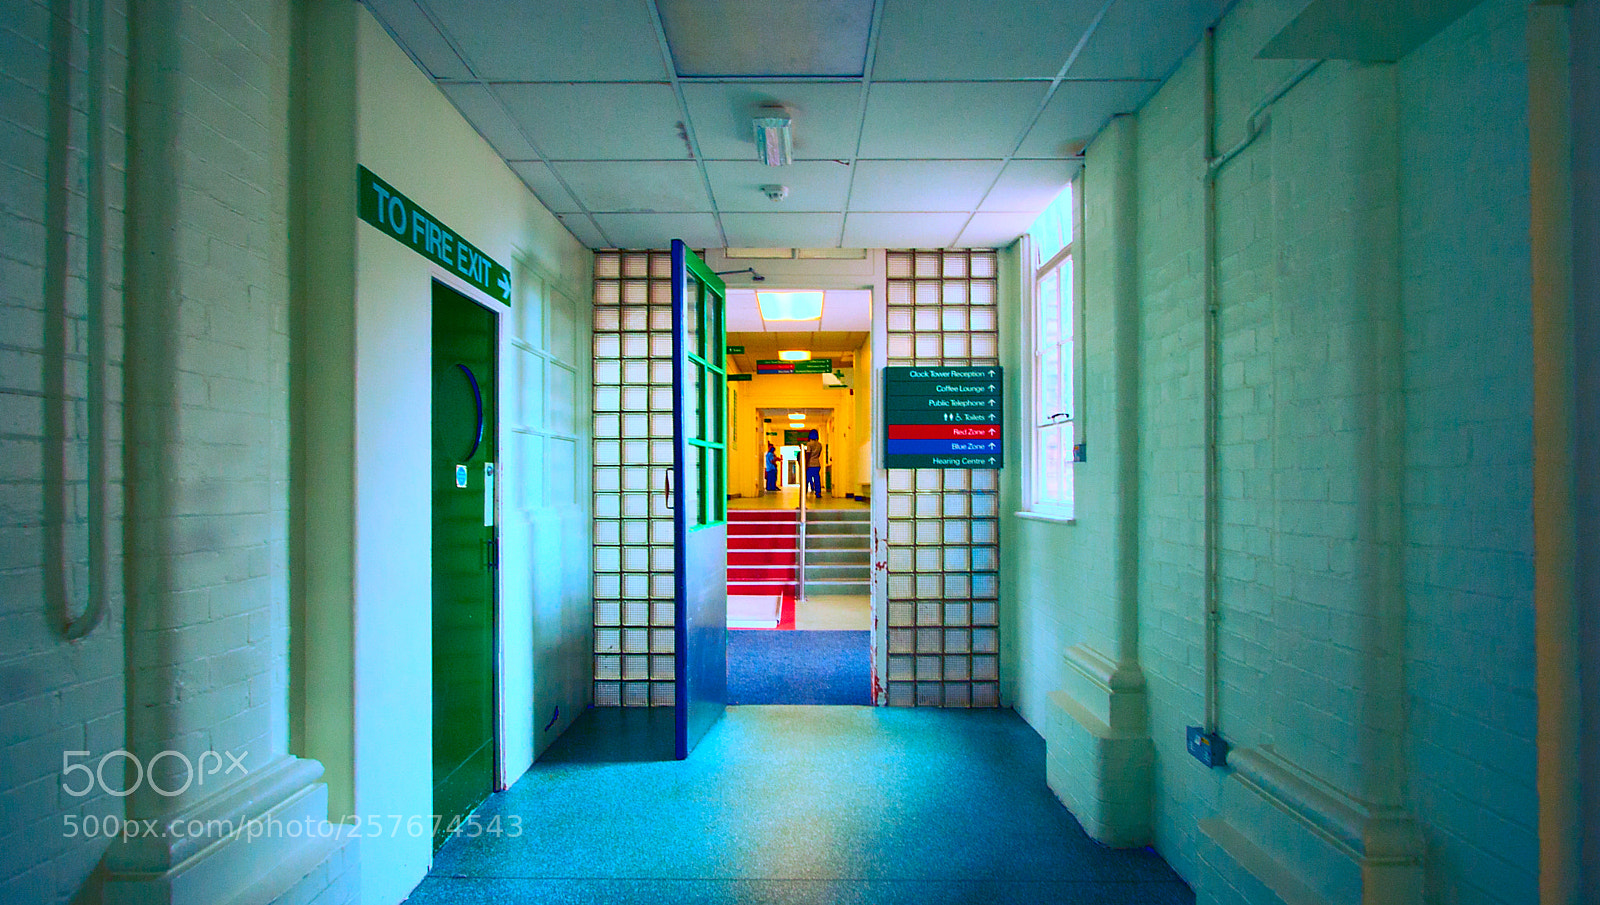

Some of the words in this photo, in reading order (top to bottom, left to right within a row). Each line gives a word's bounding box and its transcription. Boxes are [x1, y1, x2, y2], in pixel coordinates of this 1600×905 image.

[372, 182, 407, 235] TO
[412, 210, 453, 266] FIRE
[457, 241, 492, 287] EXIT
[951, 371, 985, 379] Reception
[959, 385, 985, 393] Lounge
[928, 399, 949, 407] Public
[951, 399, 985, 408] Telephone
[965, 413, 985, 421] Toilets
[932, 457, 961, 466] Hearing
[961, 457, 985, 465] Centre
